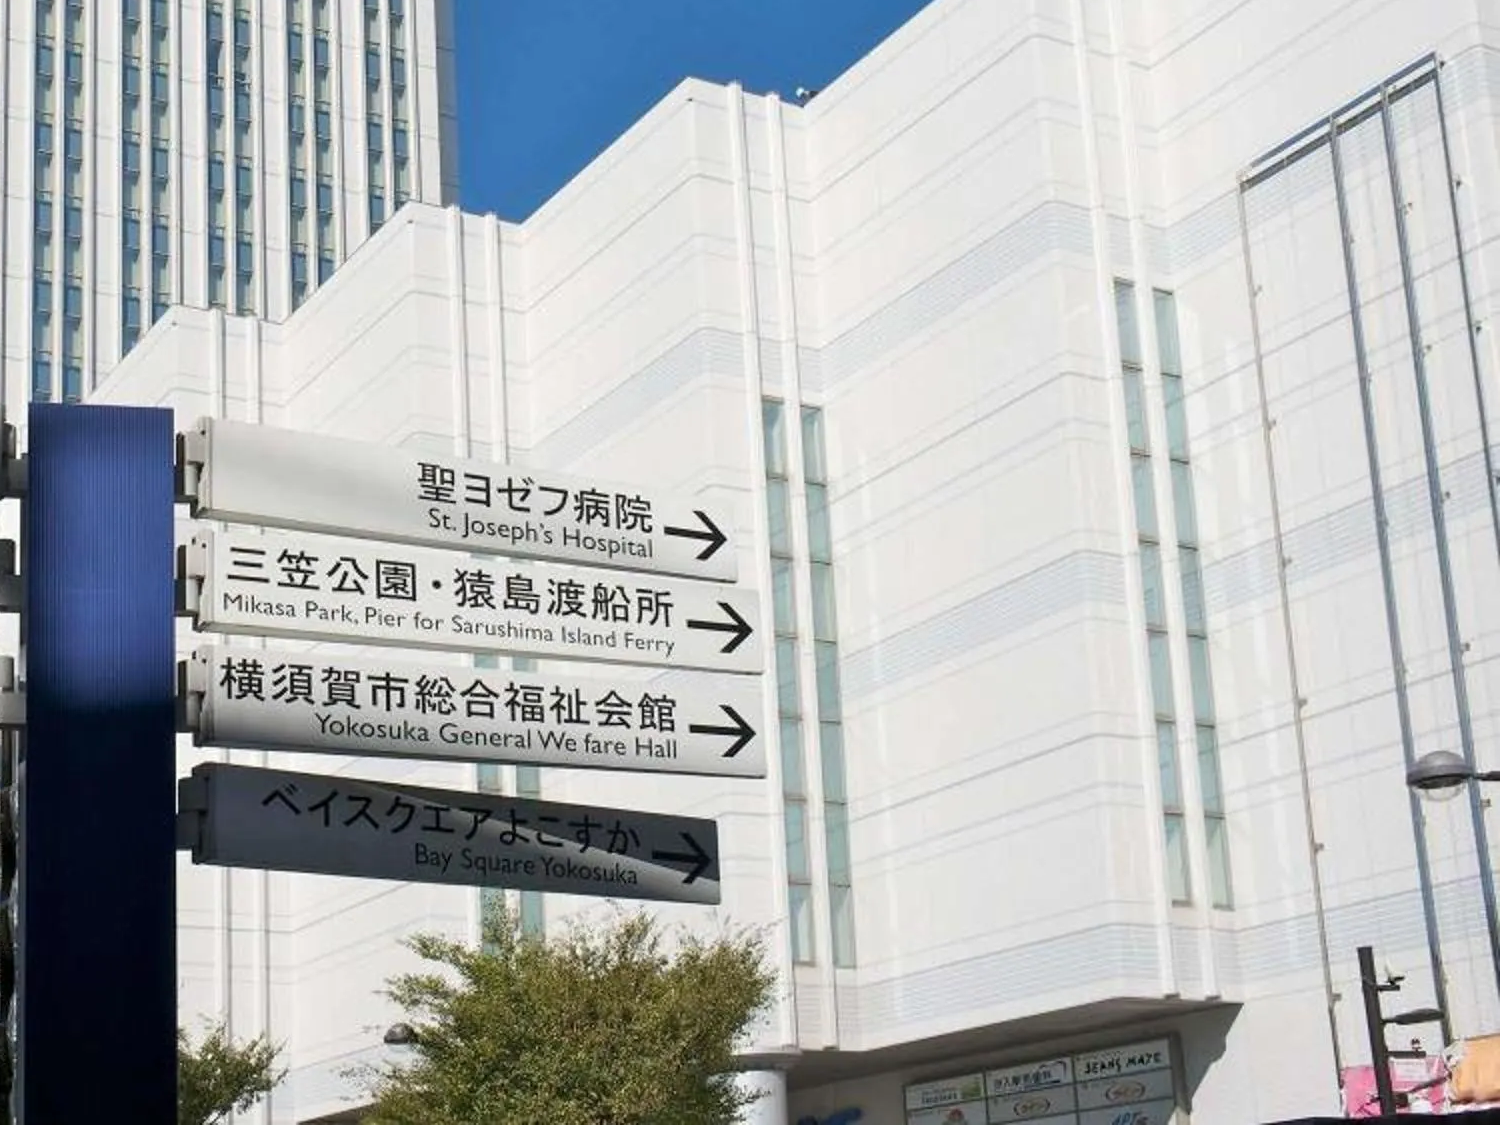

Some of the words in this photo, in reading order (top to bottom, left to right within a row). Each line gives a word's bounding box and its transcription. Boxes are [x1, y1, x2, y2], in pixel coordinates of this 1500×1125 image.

[417, 461, 653, 534] 聖ヨゼフ病院
[428, 507, 457, 532] St.
[462, 512, 553, 546] Joseph's
[563, 526, 653, 559] Hospital
[227, 546, 674, 628] 三笠公園・猿島渡船所
[222, 592, 296, 618] Mikasa
[365, 606, 407, 628] Pier
[413, 611, 444, 631] for
[451, 615, 554, 642] Sarushima
[561, 625, 617, 648] Island
[624, 631, 675, 658] Ferry
[219, 656, 677, 733] 横須賀市総合福祉会館
[314, 712, 429, 743] Yokosuka
[439, 722, 531, 749] General
[635, 736, 677, 759] Hall
[261, 783, 641, 855] ベイスクエアよこすか
[414, 841, 453, 873] Bay
[464, 848, 535, 878] Square
[540, 855, 638, 886] Yokosuka
